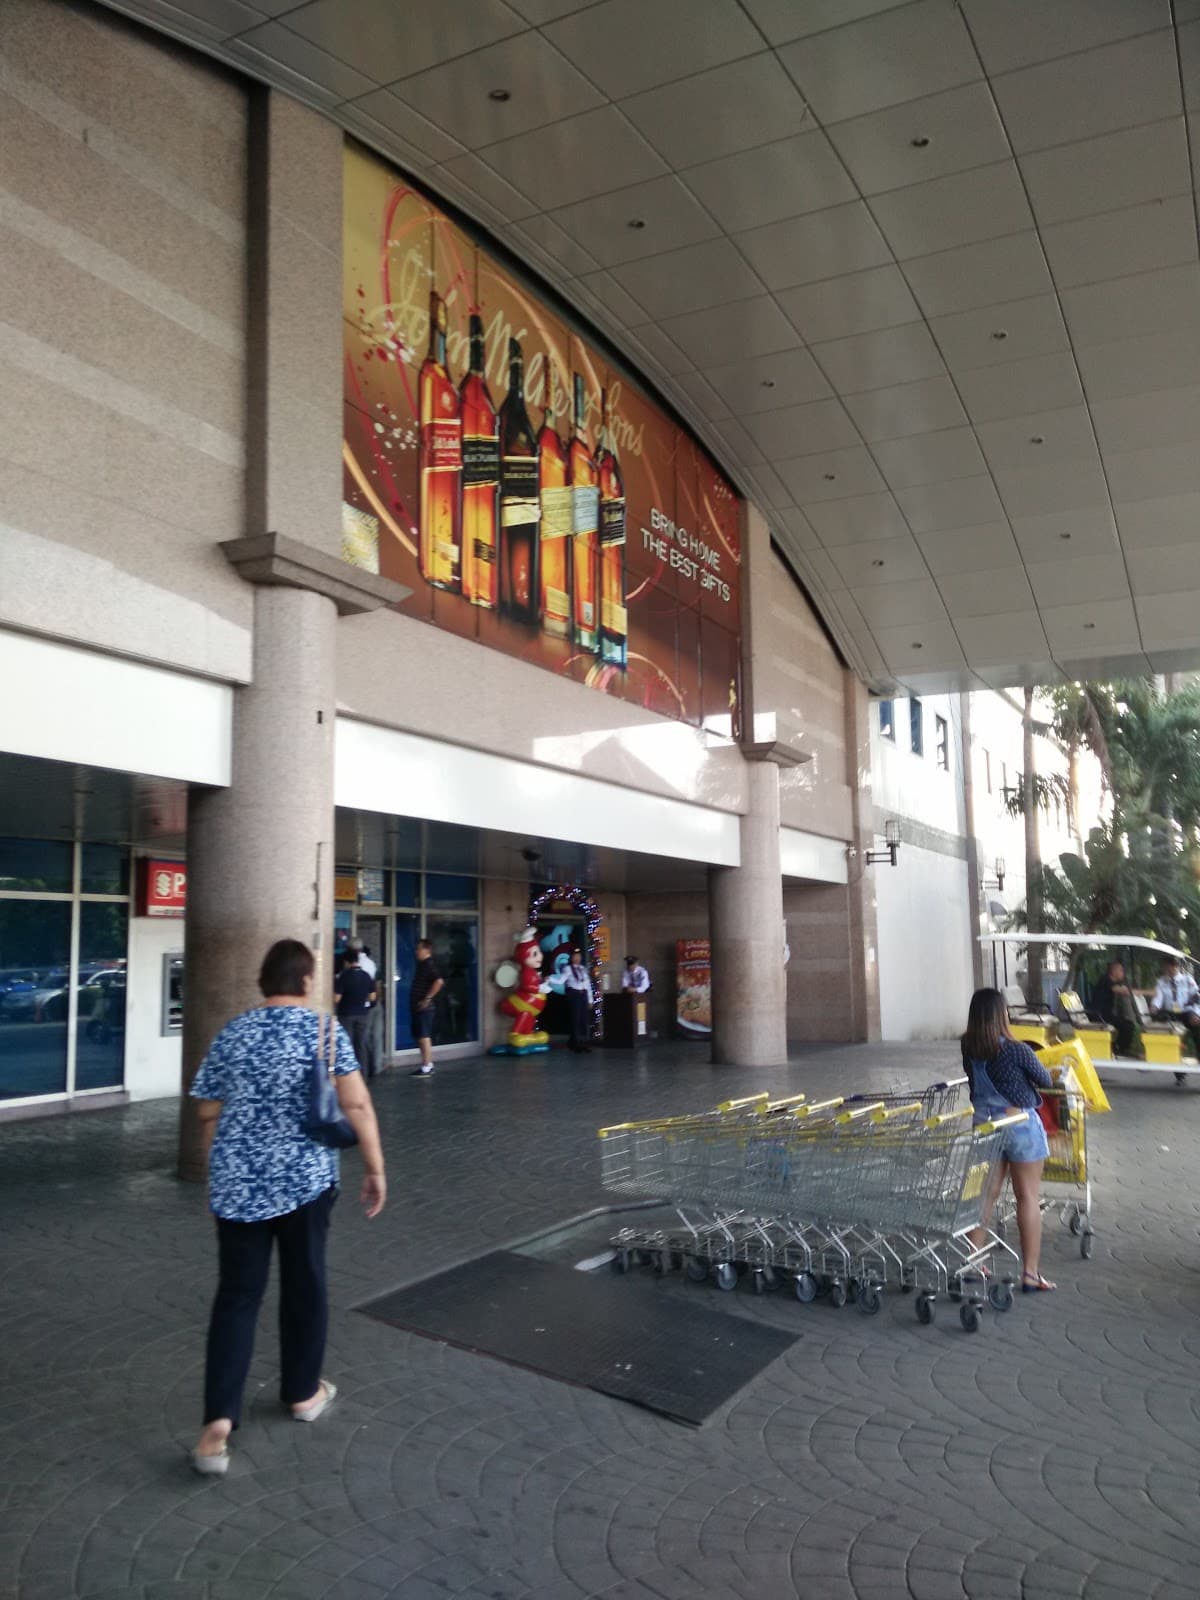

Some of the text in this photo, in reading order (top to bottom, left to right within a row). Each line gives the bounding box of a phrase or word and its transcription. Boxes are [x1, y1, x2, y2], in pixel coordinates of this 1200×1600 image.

[640, 527, 668, 562] THE
[669, 548, 699, 581] BEST
[700, 568, 731, 602] GIFTS
[650, 507, 721, 572] BRING HOME
